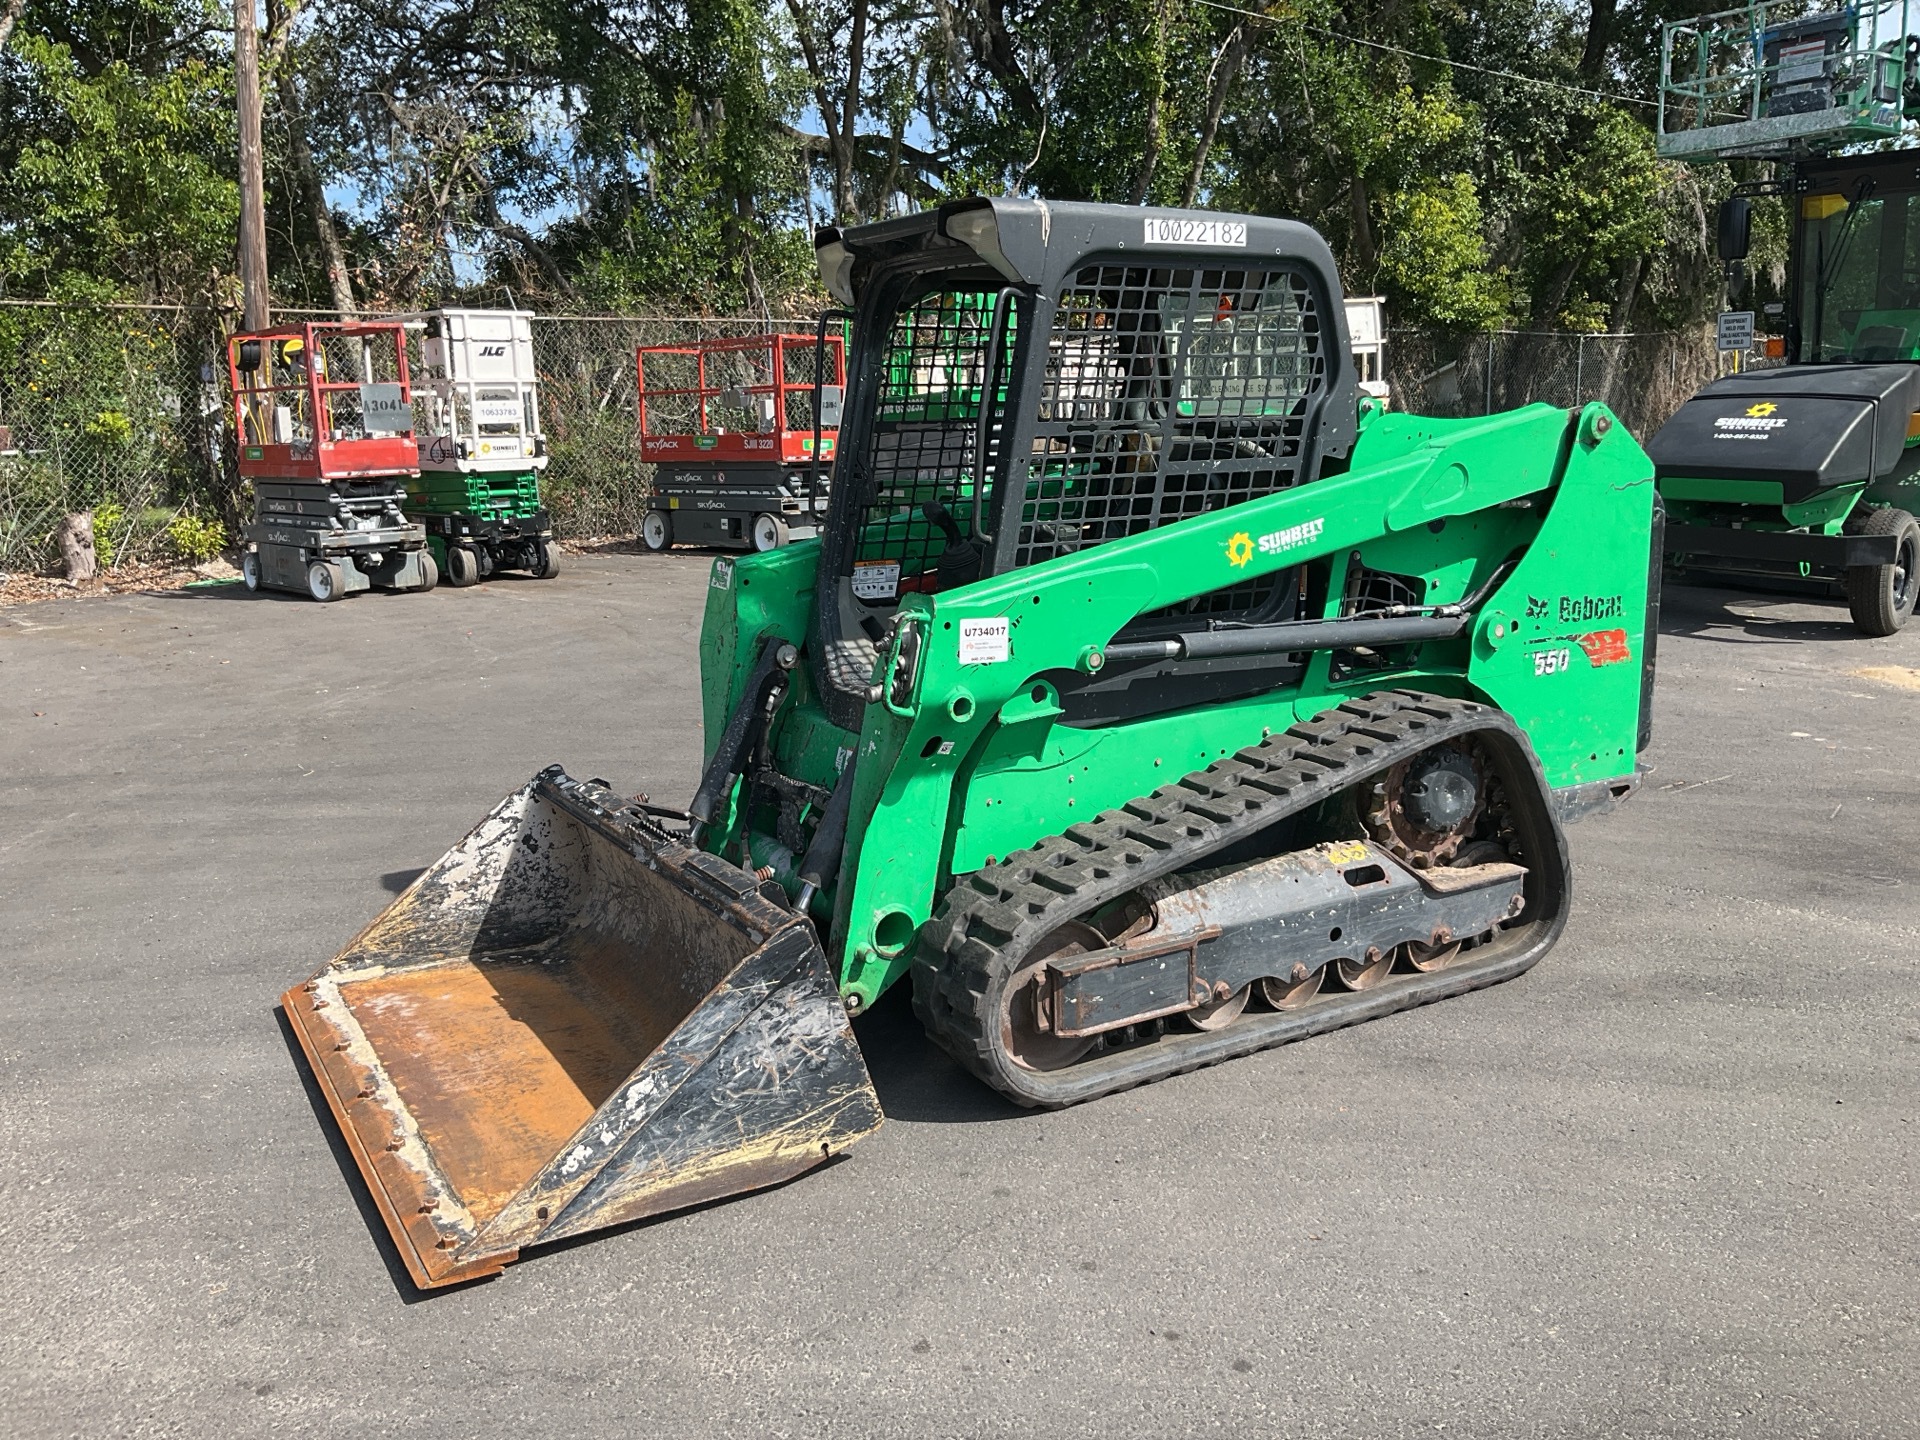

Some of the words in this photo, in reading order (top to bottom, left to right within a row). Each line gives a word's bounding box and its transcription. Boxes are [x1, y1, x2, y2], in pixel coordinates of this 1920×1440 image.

[1871, 108, 1895, 127] JLG
[1147, 220, 1244, 244] 10022182
[1723, 317, 1748, 325] EQUIPMENT
[479, 346, 506, 357] JLG
[1211, 384, 1240, 393] CLENING
[481, 408, 517, 416] 10633783
[1714, 417, 1788, 428] SUNBELT
[646, 438, 679, 450] SKYJACK
[674, 472, 702, 482] SKYJACK
[697, 500, 726, 509] SKYJACK
[1258, 518, 1325, 552] SUNBELT
[1269, 536, 1317, 555] RENTALS
[964, 626, 1006, 637] U734017
